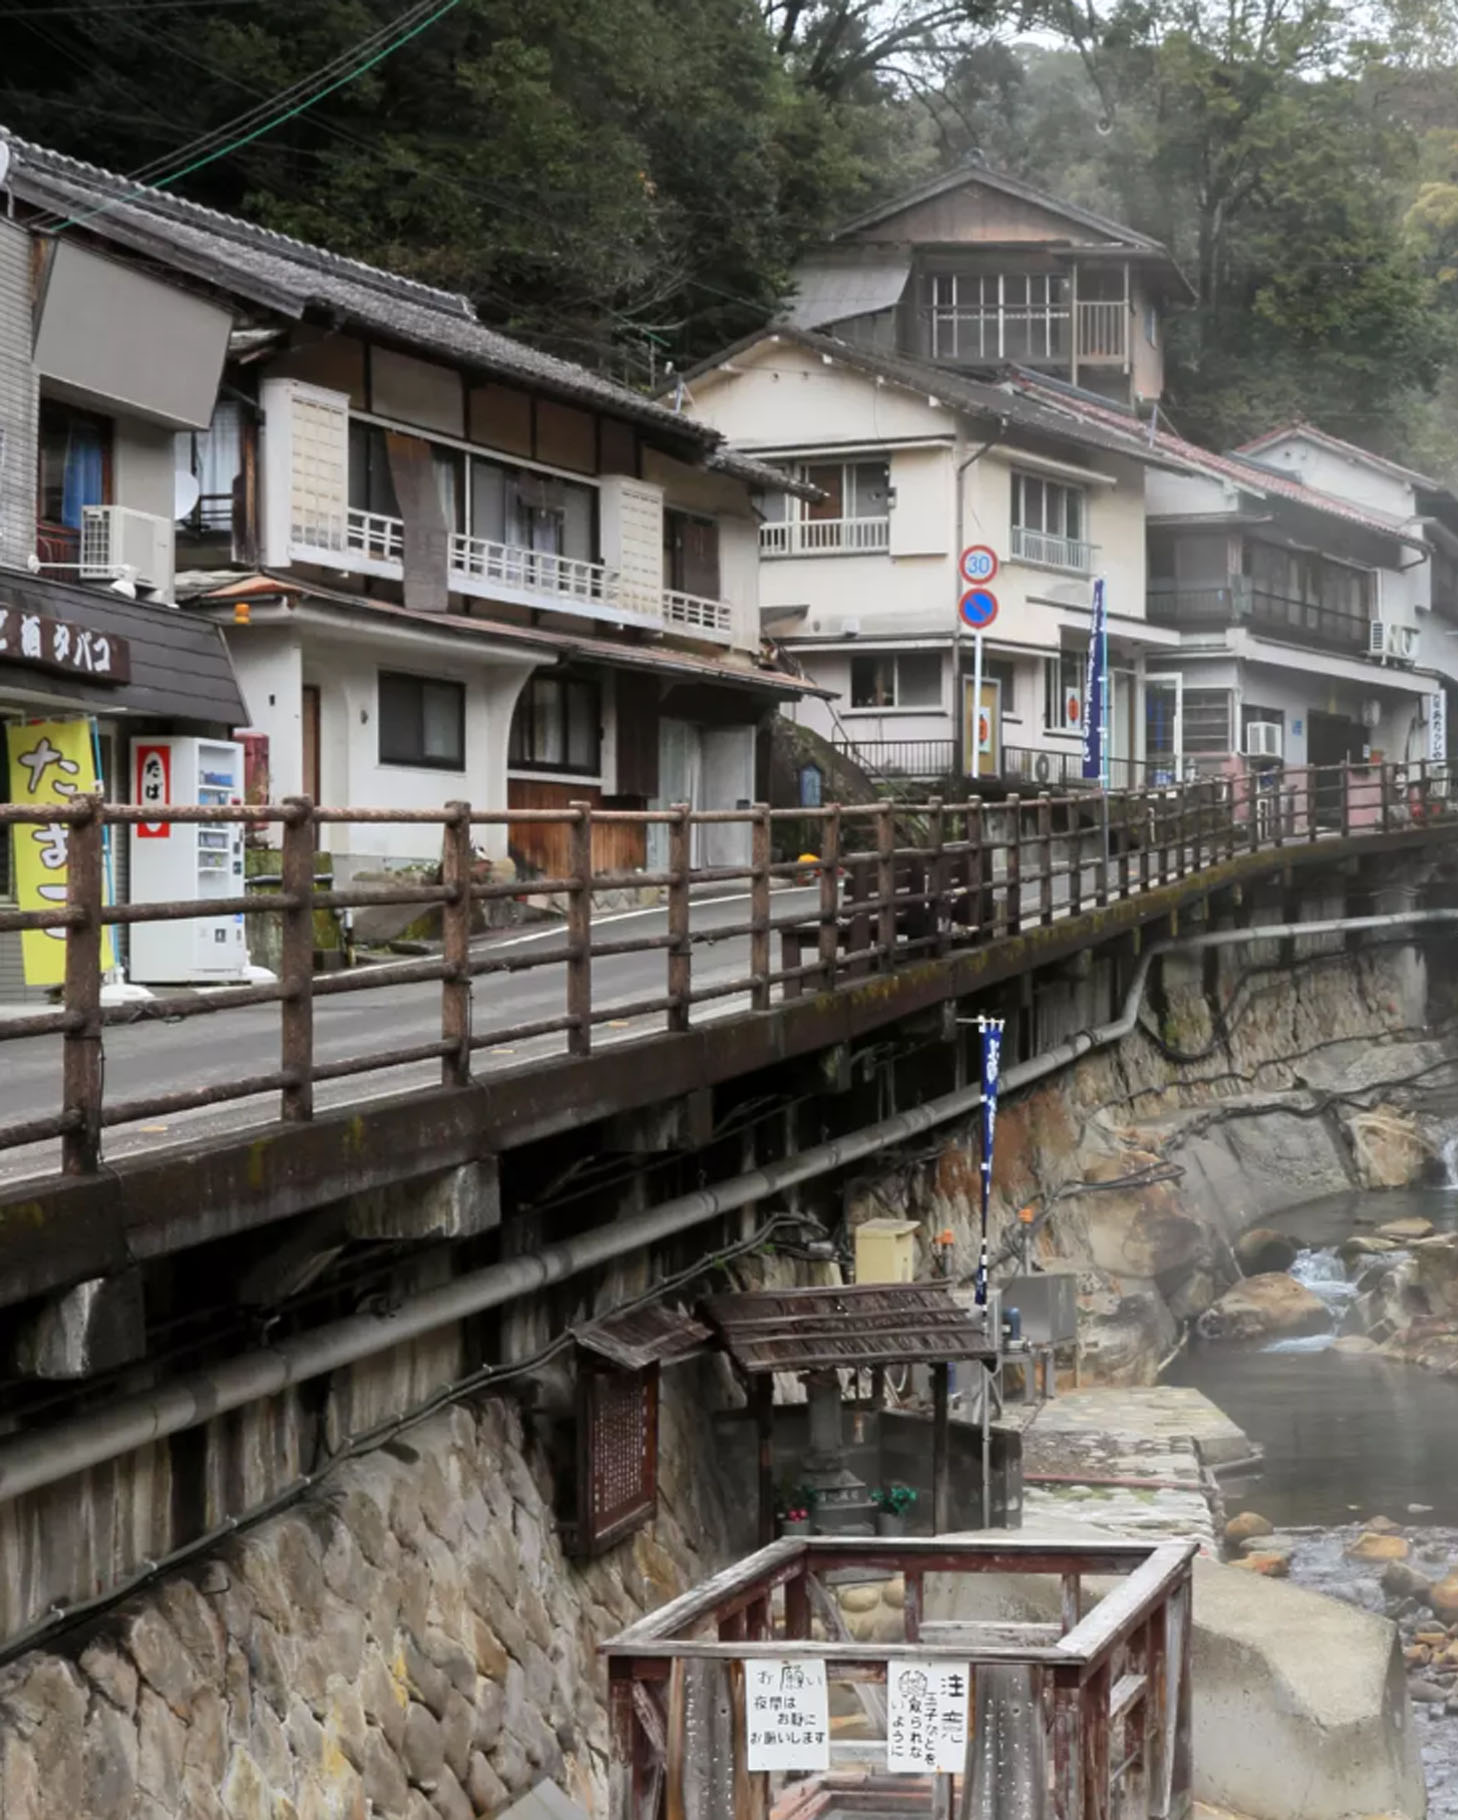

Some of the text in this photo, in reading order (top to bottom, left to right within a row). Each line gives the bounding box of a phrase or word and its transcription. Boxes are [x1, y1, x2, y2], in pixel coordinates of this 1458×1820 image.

[967, 556, 990, 574] 30
[145, 758, 163, 800] たば
[756, 1665, 823, 1691] お願い
[754, 1695, 797, 1711] 夜間は
[940, 1674, 964, 1744] 注意
[750, 1730, 826, 1745] お願いします
[891, 1700, 905, 1757] いように
